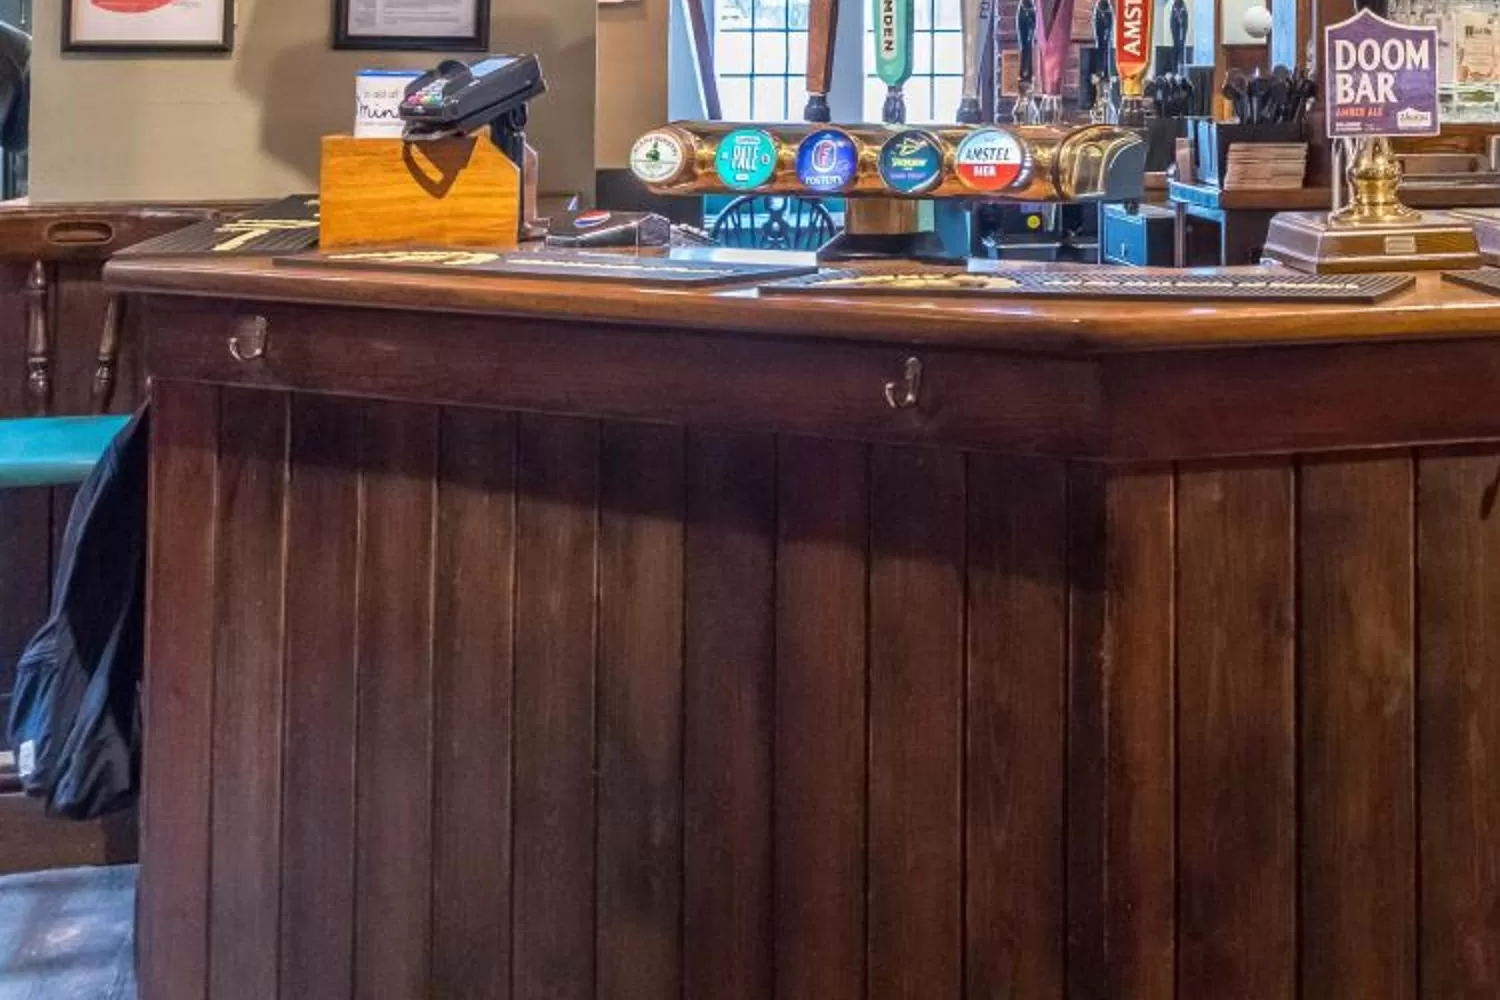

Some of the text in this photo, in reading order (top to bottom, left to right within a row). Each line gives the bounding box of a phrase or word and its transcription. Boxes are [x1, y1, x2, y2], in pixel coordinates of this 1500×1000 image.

[1335, 38, 1429, 71] DOOM
[1335, 72, 1398, 104] BAR
[965, 147, 1010, 161] AMSTEL
